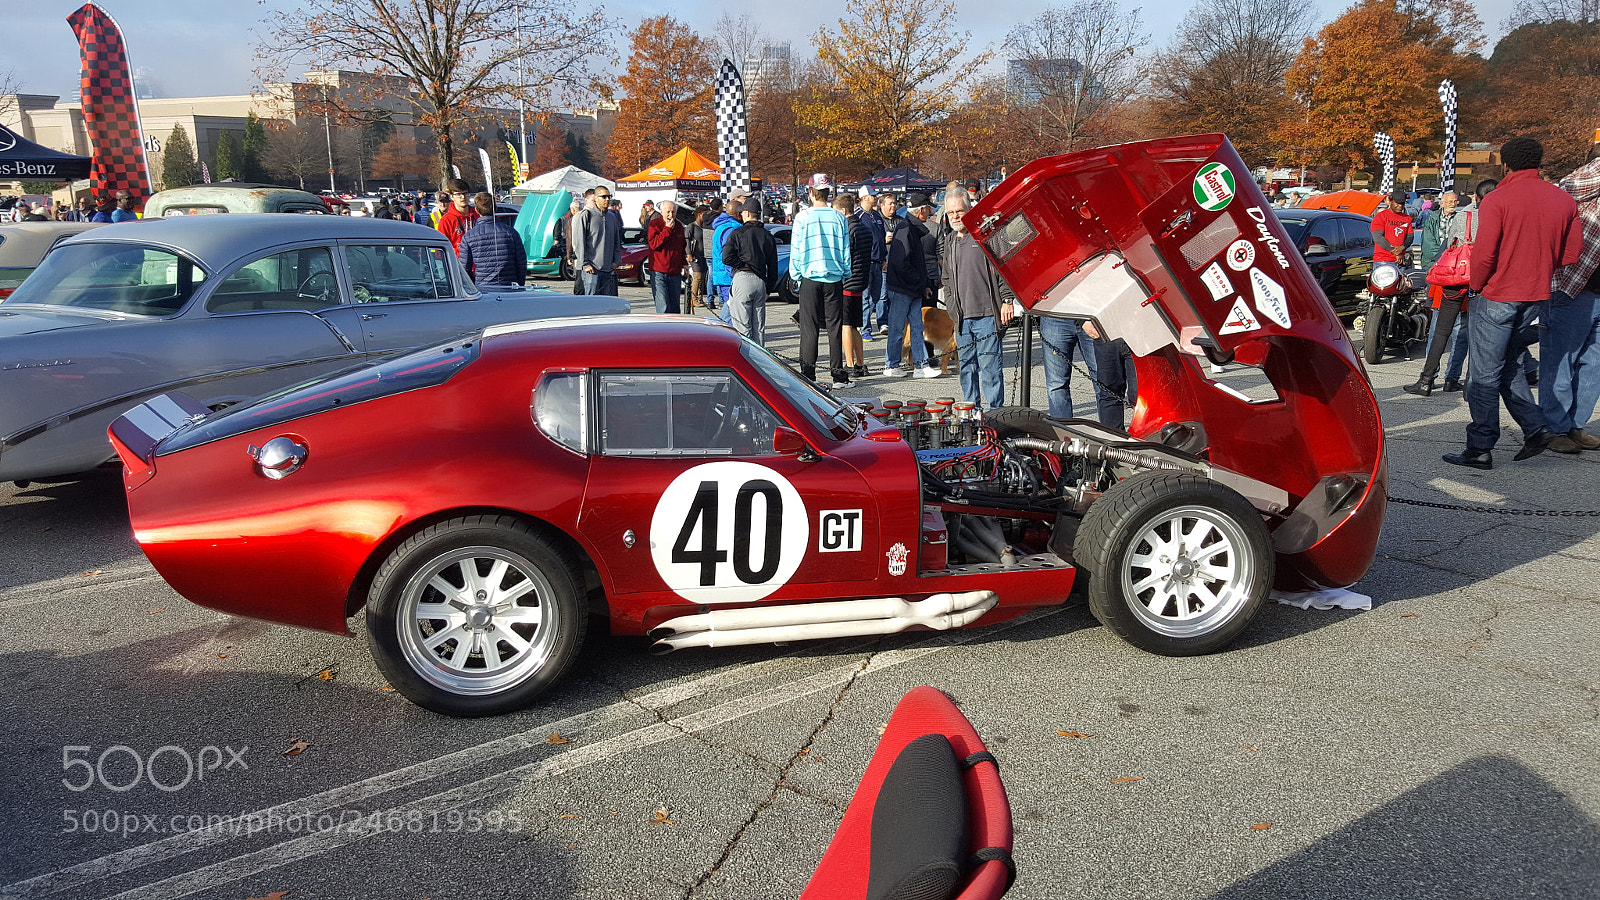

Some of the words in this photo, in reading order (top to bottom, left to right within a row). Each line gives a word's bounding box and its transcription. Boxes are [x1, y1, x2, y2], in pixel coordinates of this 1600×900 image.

[1204, 169, 1231, 201] Castrol
[1246, 206, 1290, 270] Daytona
[671, 478, 783, 587] 40
[822, 512, 860, 550] GT
[891, 564, 904, 572] VHT
